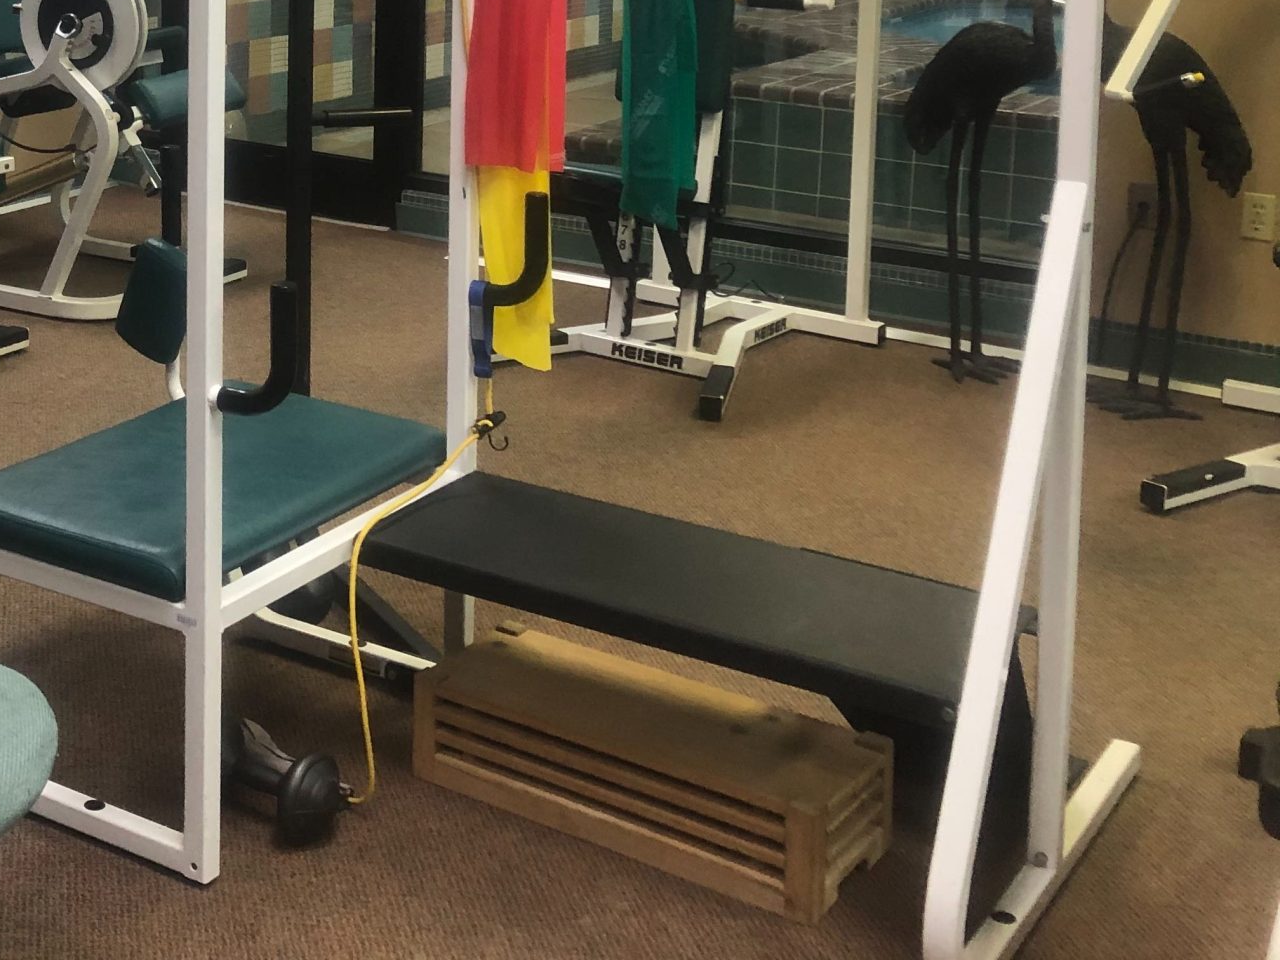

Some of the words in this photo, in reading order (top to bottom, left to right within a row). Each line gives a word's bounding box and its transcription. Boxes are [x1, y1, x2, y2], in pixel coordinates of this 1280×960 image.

[621, 225, 628, 235] 7
[620, 240, 626, 250] 8
[754, 317, 787, 343] KEISER
[611, 342, 683, 369] KEISER
